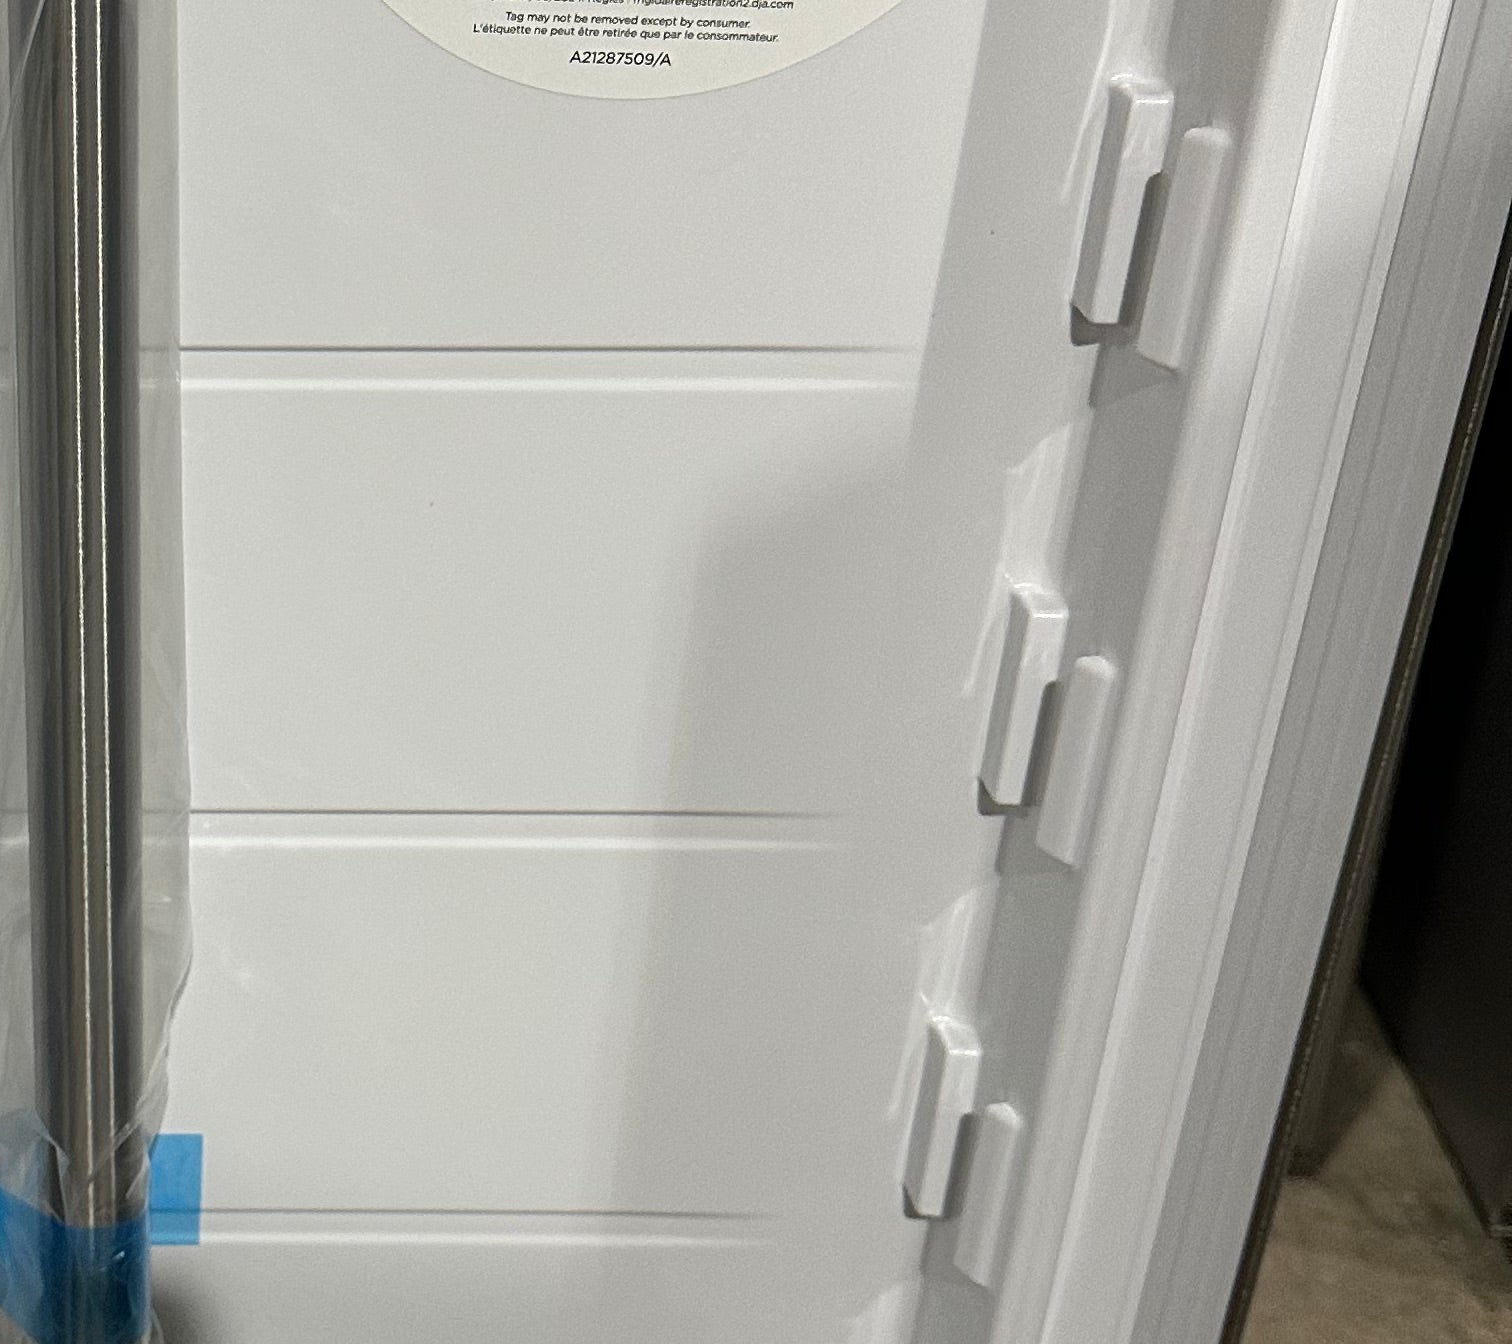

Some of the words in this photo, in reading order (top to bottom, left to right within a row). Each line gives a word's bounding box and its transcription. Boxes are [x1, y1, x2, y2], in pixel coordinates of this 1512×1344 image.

[505, 11, 524, 22] Tag
[526, 13, 550, 23] may
[552, 13, 571, 22] not
[573, 13, 588, 23] be
[590, 15, 638, 24] removed
[640, 17, 677, 26] except
[679, 16, 694, 28] by
[696, 19, 750, 28] consumer.
[569, 50, 671, 67] A21287509/A
